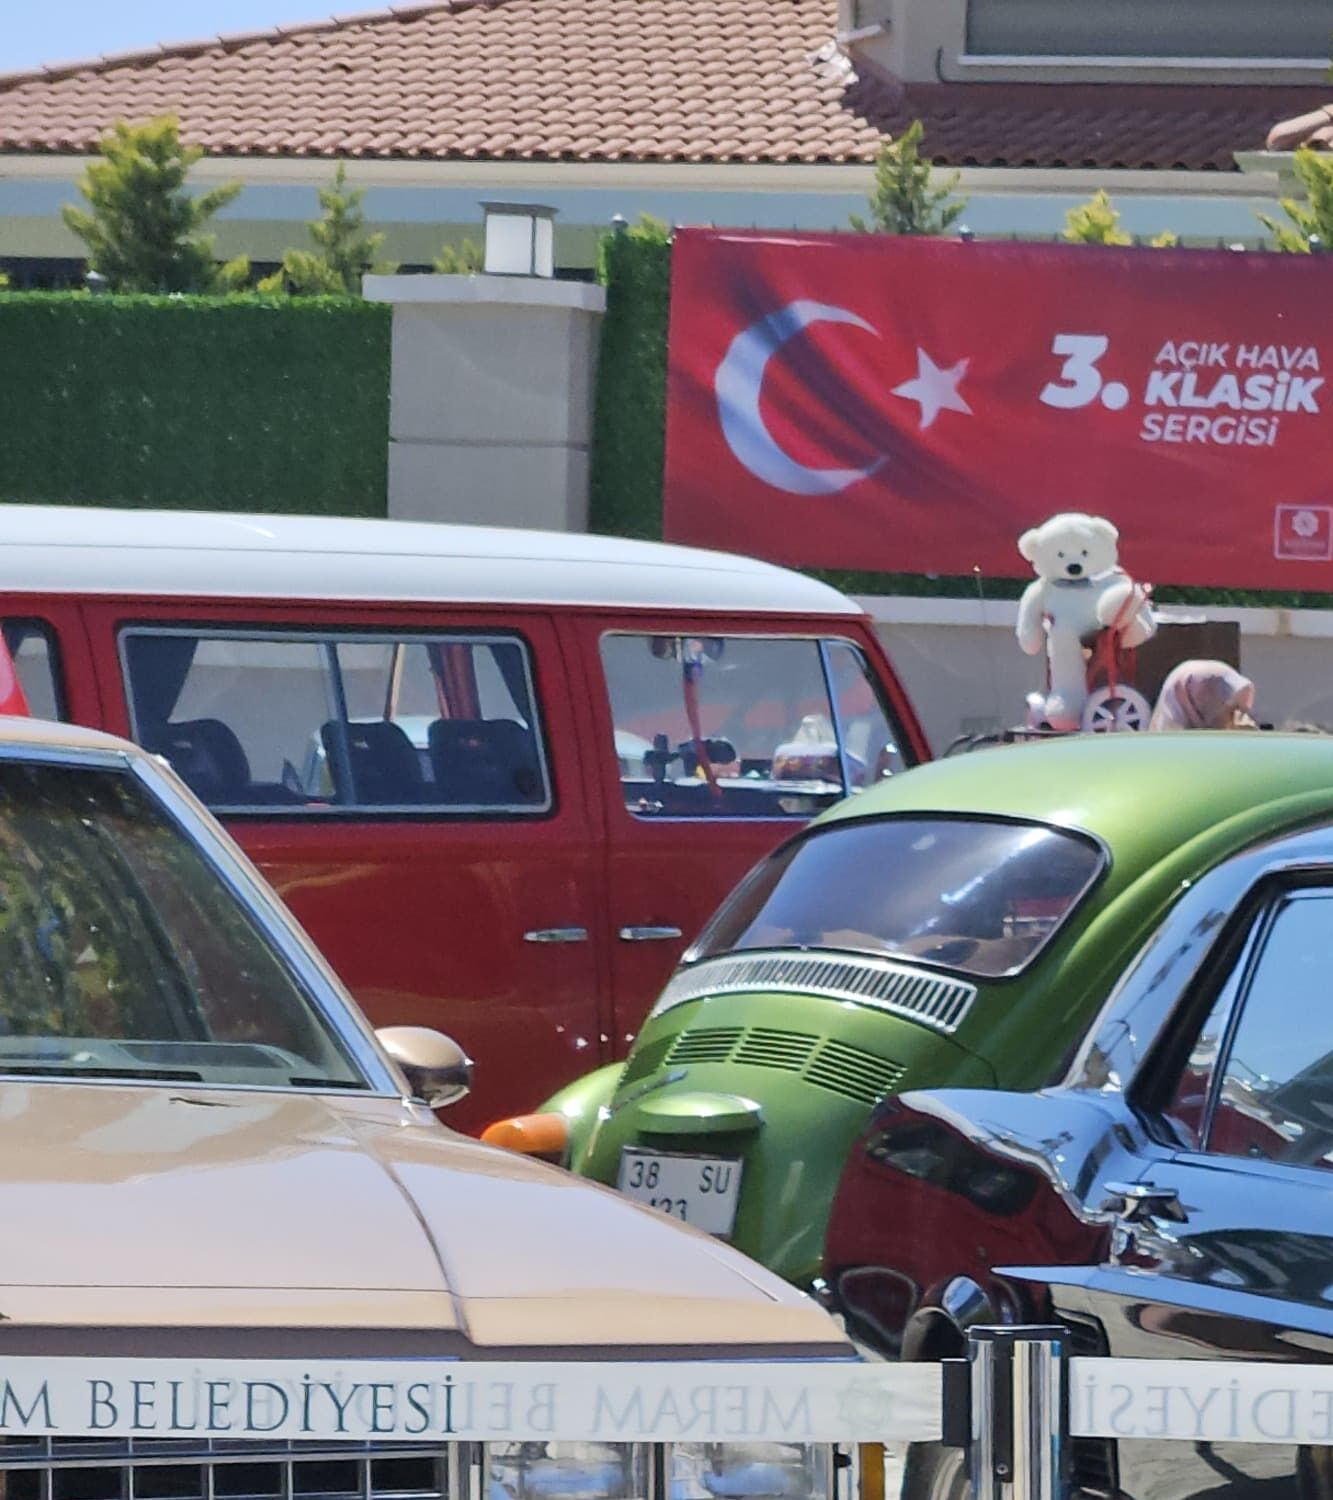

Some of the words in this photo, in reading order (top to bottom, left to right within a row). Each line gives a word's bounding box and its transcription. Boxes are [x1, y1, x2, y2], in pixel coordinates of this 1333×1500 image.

[1040, 334, 1129, 410] 3.
[1156, 341, 1230, 372] AÇIK
[1236, 345, 1319, 371] HAVA
[629, 1161, 660, 1189] 38
[699, 1165, 732, 1194] SU
[86, 1374, 458, 1434] BELEDİYESİ
